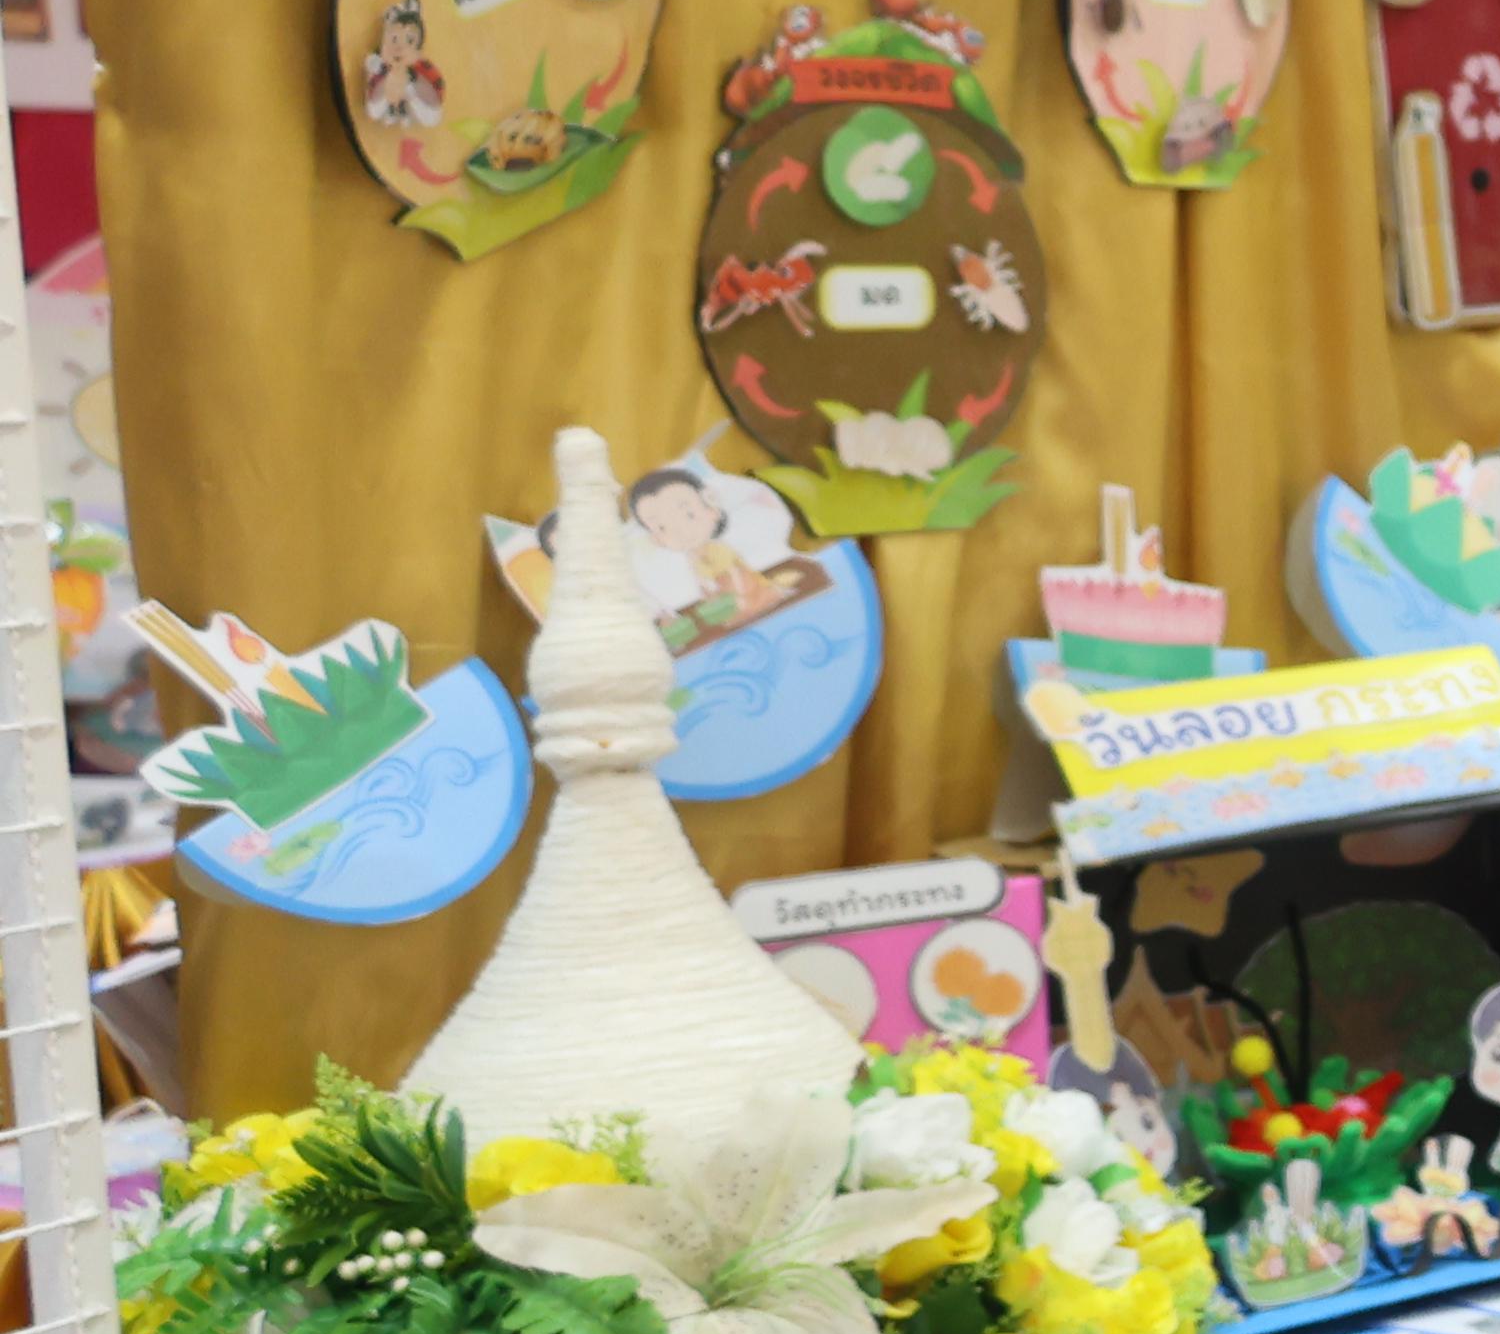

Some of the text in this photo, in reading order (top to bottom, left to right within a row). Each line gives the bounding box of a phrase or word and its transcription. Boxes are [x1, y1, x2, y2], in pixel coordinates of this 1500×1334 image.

[1080, 663, 1500, 768] วันลอย กระทง
